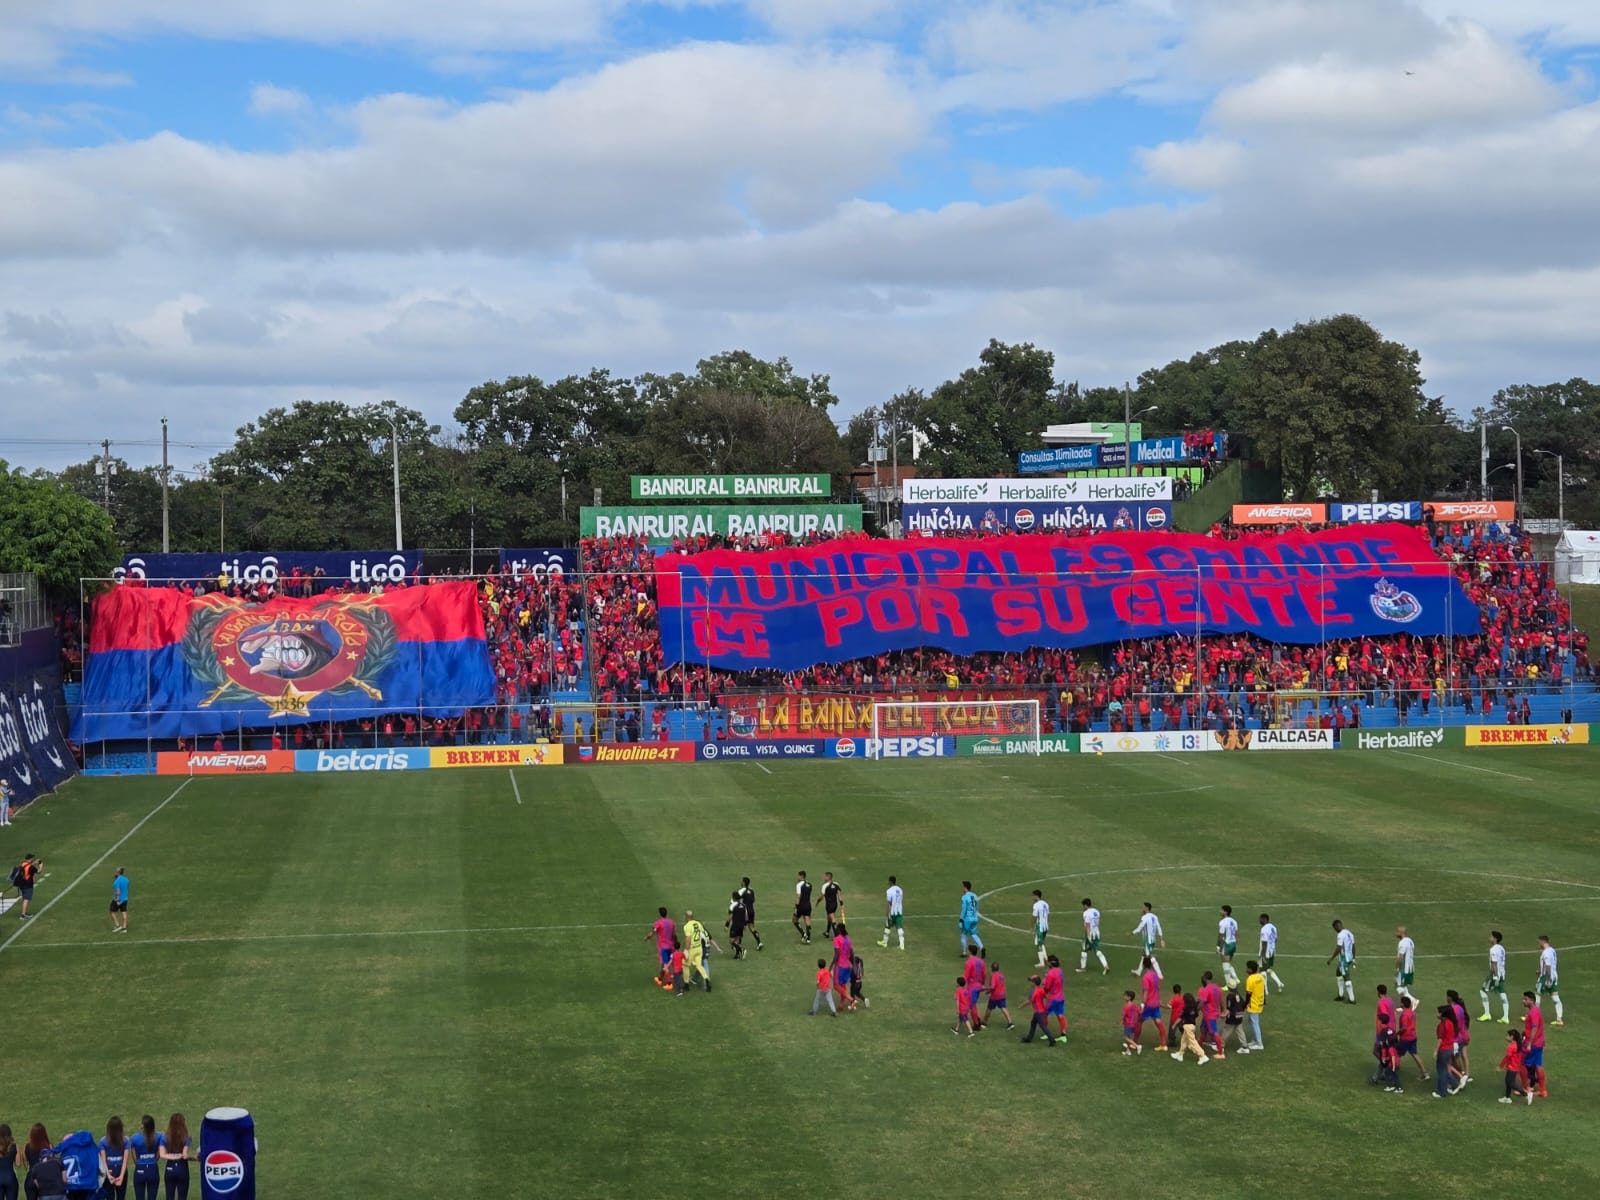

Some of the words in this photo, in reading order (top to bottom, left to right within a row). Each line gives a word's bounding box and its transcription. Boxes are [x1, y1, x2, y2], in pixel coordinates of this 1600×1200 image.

[1020, 451, 1054, 463] Consultas
[1055, 447, 1092, 460] Ilimitadas
[1137, 440, 1175, 460] Medical
[639, 478, 728, 495] BANRURAL
[734, 477, 823, 494] BANRURAL
[909, 485, 978, 499] Herbalife
[999, 484, 1068, 499] Herbalife
[1088, 483, 1156, 498] Herbalife
[909, 506, 973, 530] HINCHA
[1042, 505, 1107, 528] HINCHA
[1248, 506, 1312, 518] AMÉRICA
[1342, 503, 1410, 520] PEPSI
[596, 514, 716, 538] BANRURAL
[221, 556, 279, 584] tigo
[350, 554, 406, 583] tigo
[677, 548, 1038, 606] MUNICIPAL
[817, 589, 969, 648] POR
[992, 588, 1089, 637] SU
[1111, 579, 1354, 626] GENTE
[1182, 735, 1195, 750] 13
[1258, 730, 1328, 742] GALCASA
[1358, 731, 1434, 749] Herbalife
[1480, 729, 1548, 742] BREMEN
[596, 745, 658, 761] Havoline
[658, 747, 680, 760] 4T
[722, 745, 750, 756] HOTEL
[755, 744, 779, 755] VISTA
[783, 744, 816, 754] QUINCE
[865, 737, 944, 757] PEPSI
[1006, 740, 1070, 754] BANRURAL
[188, 753, 267, 767] AMÉRICA
[317, 750, 409, 771] betcris
[446, 749, 521, 765] BREMEN
[206, 1165, 240, 1176] PEPSI
